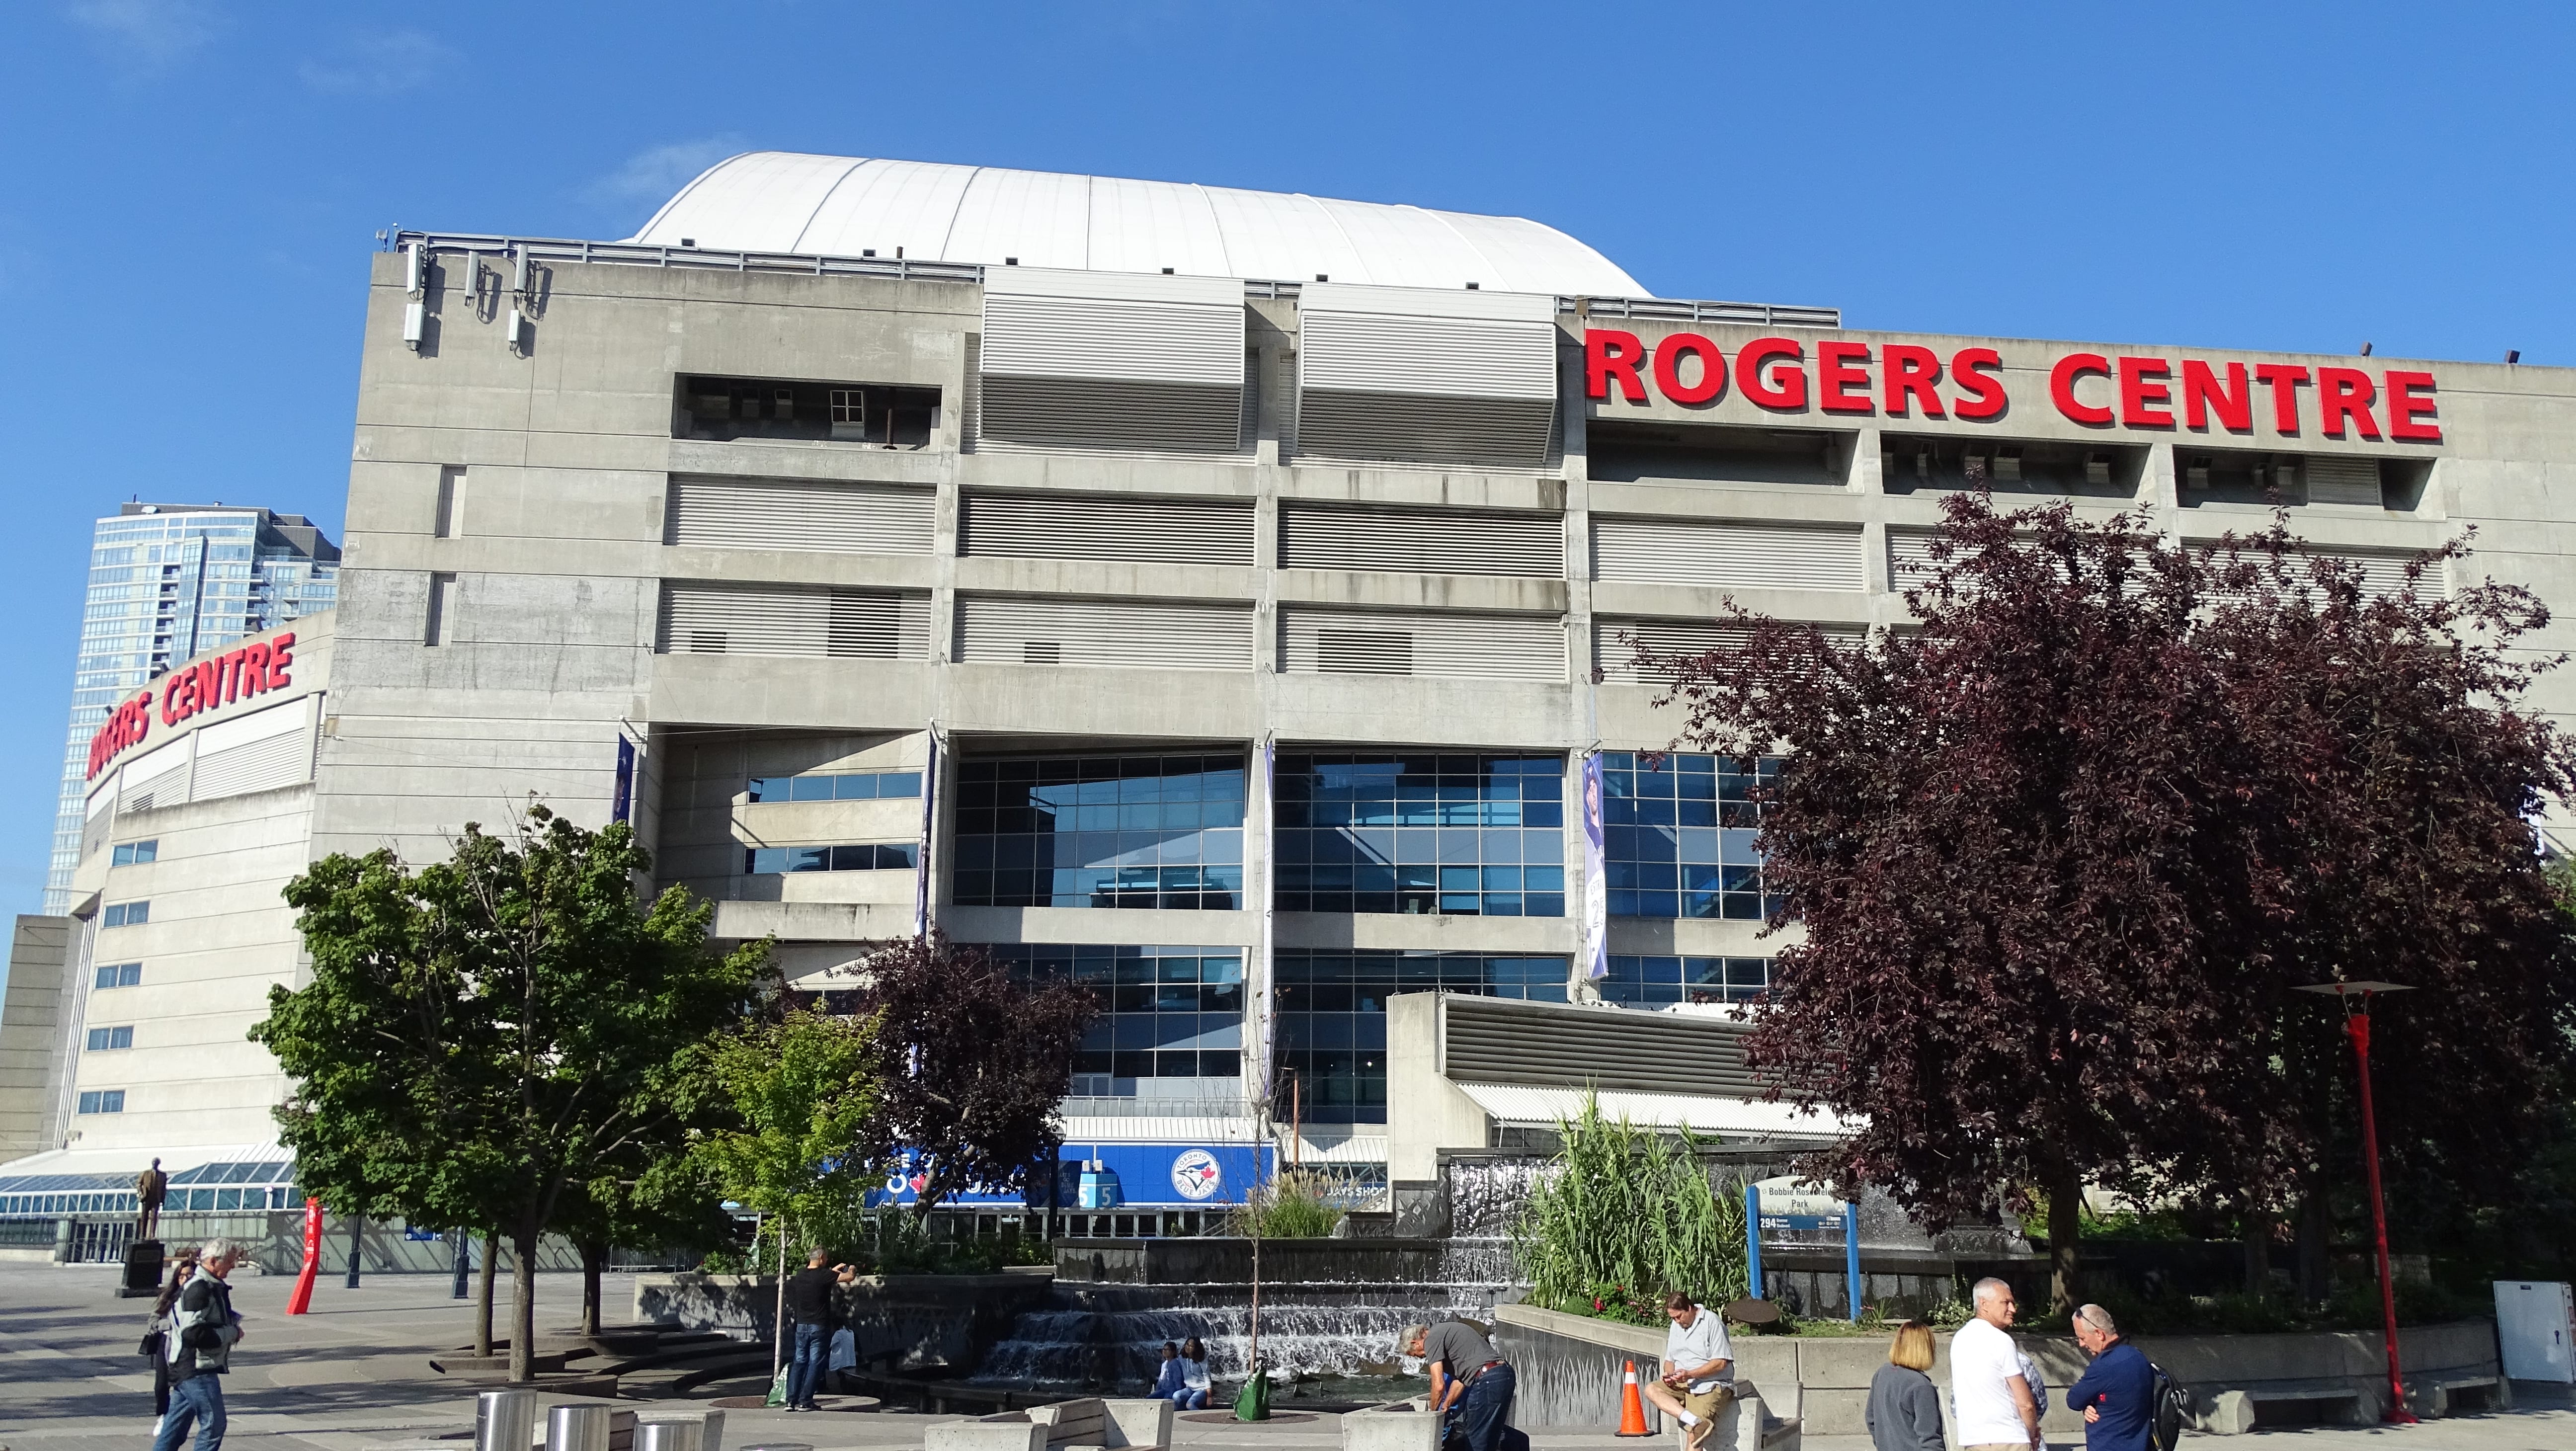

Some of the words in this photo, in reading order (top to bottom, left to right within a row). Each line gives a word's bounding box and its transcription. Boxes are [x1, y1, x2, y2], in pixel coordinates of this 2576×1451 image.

[1585, 327, 2007, 418] ROGERS
[2049, 352, 2442, 442] CENTRE
[161, 632, 297, 727] CENTRE
[1591, 896, 1605, 928] 25
[1177, 1153, 1207, 1169] TORONTO
[1176, 1179, 1194, 1195] BLUE
[1198, 1180, 1215, 1196] JAYS
[1327, 1186, 1354, 1197] JAYS
[1769, 1187, 1794, 1196] Bobbie
[1796, 1187, 1832, 1196] Rosel
[1079, 1187, 1088, 1206] 5
[1102, 1187, 1111, 1206] 5
[1791, 1199, 1809, 1208] Park
[1760, 1217, 1776, 1228] 294
